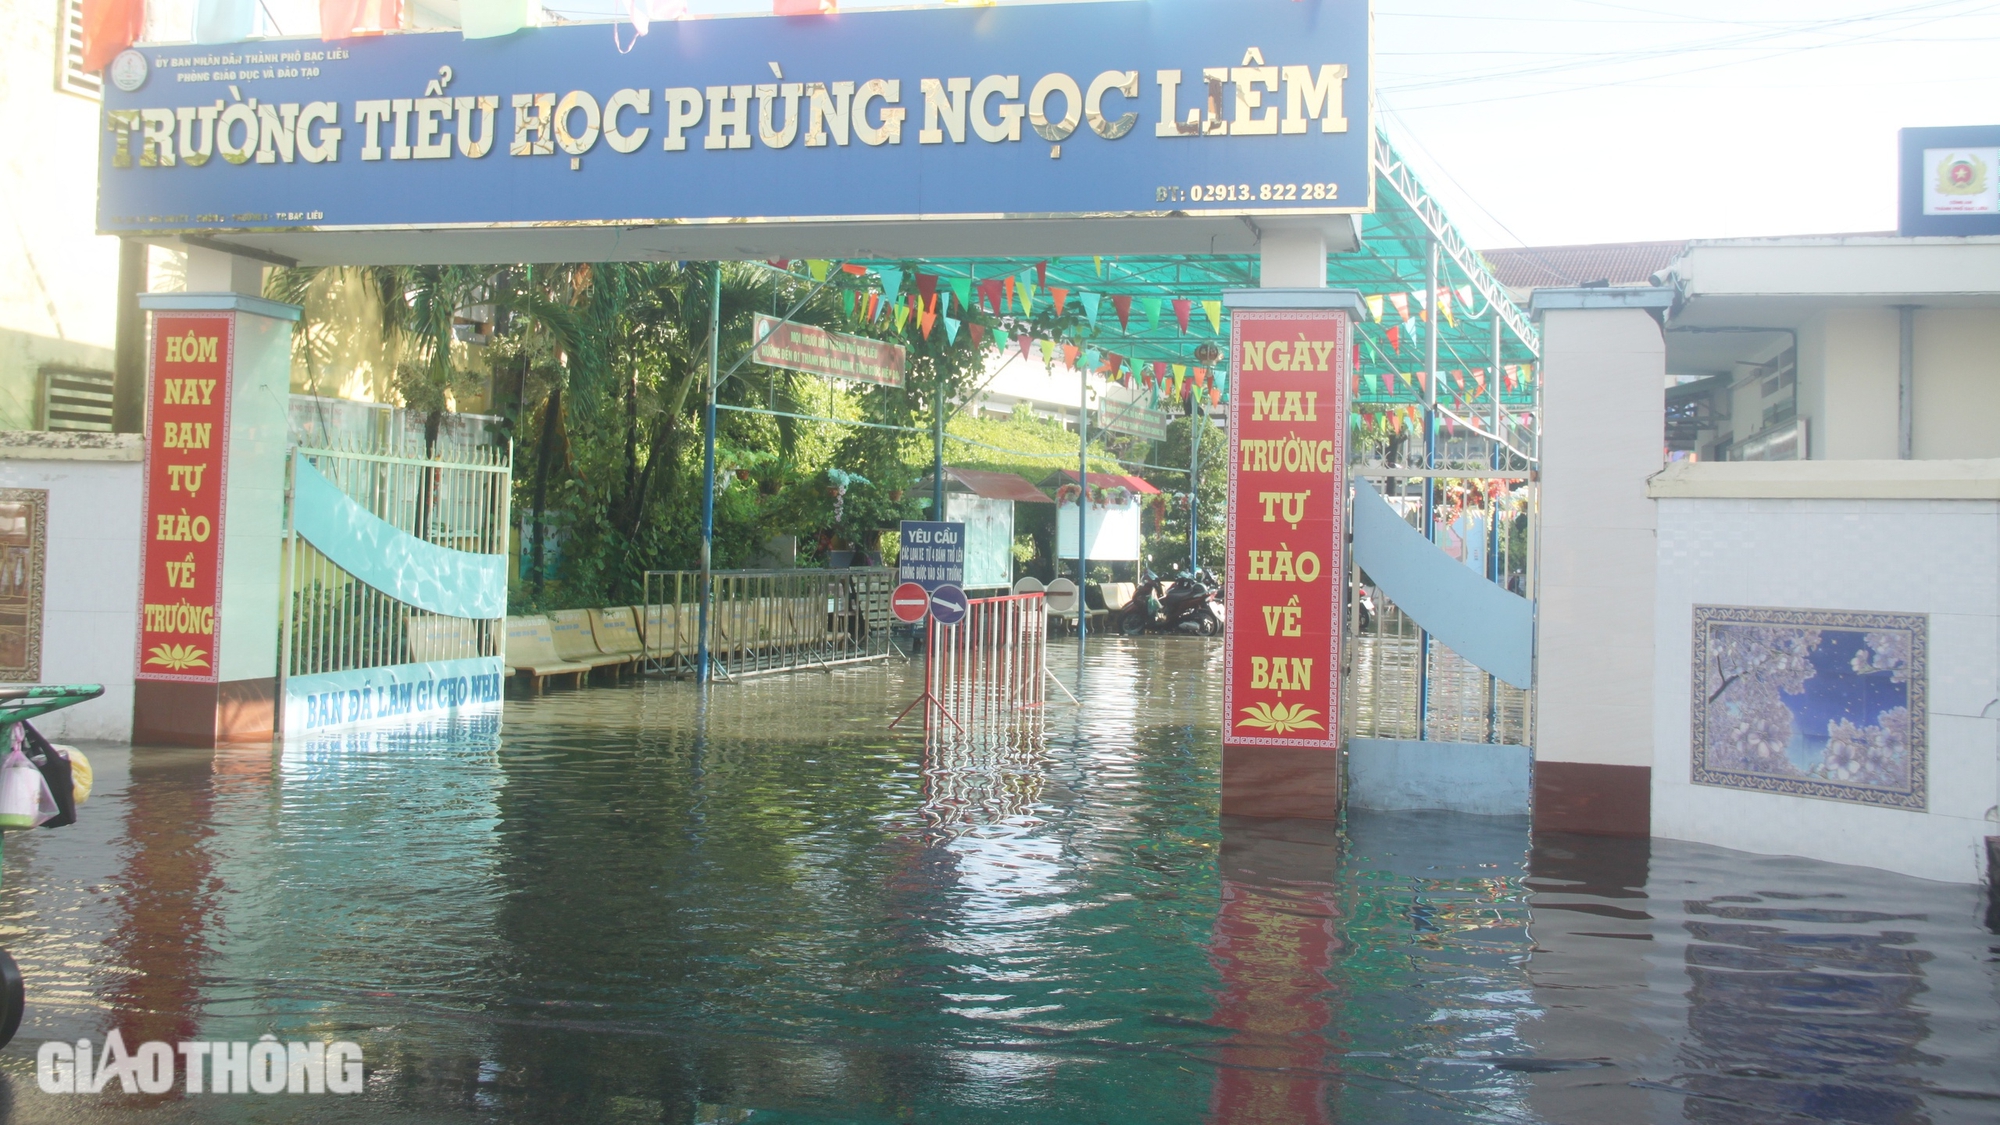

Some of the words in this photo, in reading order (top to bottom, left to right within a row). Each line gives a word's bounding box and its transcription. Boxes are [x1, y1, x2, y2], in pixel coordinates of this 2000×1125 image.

[171, 57, 191, 67] BAN
[194, 54, 220, 66] NHÂN
[222, 52, 242, 65] DÂN
[245, 51, 279, 64] THÀNH
[304, 51, 325, 64] BẠC
[327, 47, 349, 60] LIÊU
[178, 70, 210, 82] PHÒNG
[213, 68, 236, 80] GIÁO
[240, 70, 260, 83] DỤC
[264, 66, 274, 78] VÀ
[278, 66, 298, 78] ĐÀO
[301, 67, 320, 80] TẠO
[107, 85, 342, 168] TRƯỜNG
[355, 65, 500, 160] TIỂU
[510, 88, 650, 171] HỌC
[664, 62, 906, 151] PHÙNG
[919, 70, 1139, 159] NGỌC
[1155, 46, 1349, 137] LIÊM
[1190, 184, 1256, 202] 02913.
[1259, 183, 1296, 201] 822
[1301, 183, 1337, 200] 282
[166, 330, 218, 362] HÔM
[1242, 332, 1334, 371] NGÀY
[164, 379, 216, 405] NAY
[1252, 391, 1317, 422] MAI
[164, 422, 212, 454] BẠN
[1240, 431, 1334, 473] TRƯỜNG
[168, 463, 206, 498] TỰ
[156, 508, 210, 542] HÀO
[1259, 490, 1311, 530] TỰ
[908, 528, 931, 543] YÊU
[934, 527, 957, 544] CẦU
[166, 552, 196, 588] VỀ
[1248, 542, 1321, 582] HÀO
[145, 598, 214, 635] TRƯỜNG
[1262, 595, 1301, 637] VỀ
[1251, 656, 1313, 697] BẠN
[306, 690, 346, 734] BẠN
[348, 679, 372, 722] ĐÃ
[377, 675, 413, 718] LÀM
[416, 671, 434, 712] GÌ
[437, 676, 468, 709] CHO
[471, 664, 500, 704] NHÀ
